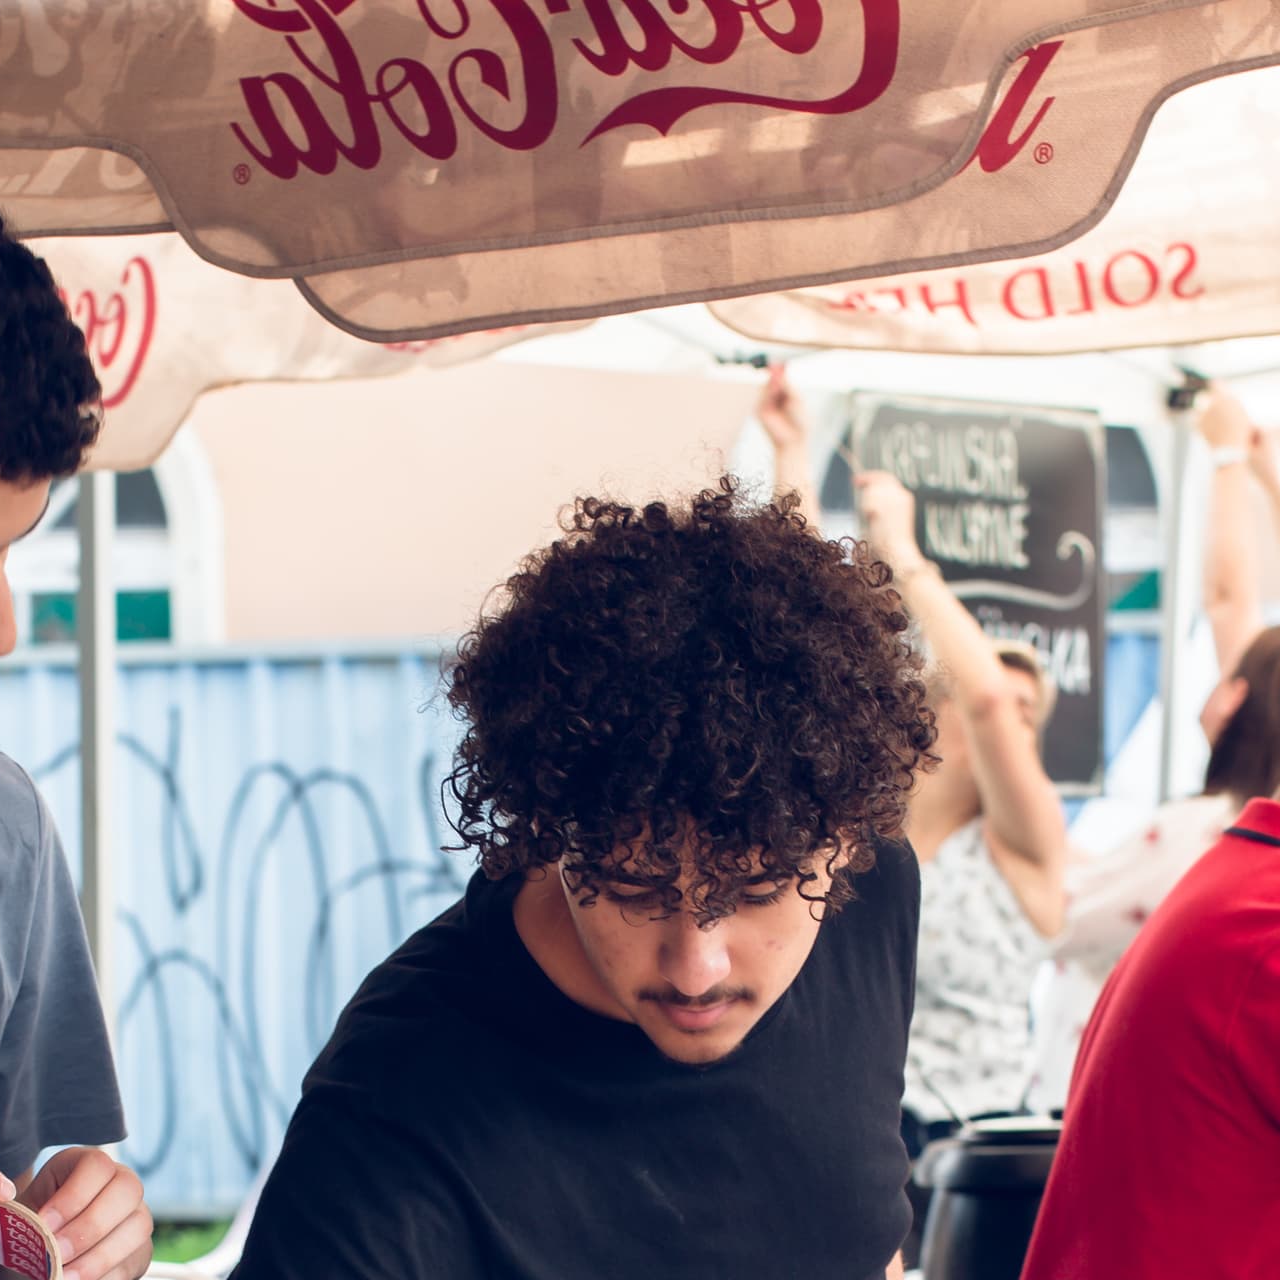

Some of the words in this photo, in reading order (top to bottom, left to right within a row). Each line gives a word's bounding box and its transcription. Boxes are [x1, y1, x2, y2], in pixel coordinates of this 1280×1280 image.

[4, 1214, 42, 1247] tesa
[6, 1227, 43, 1260] tesa
[8, 1240, 45, 1272] tesa
